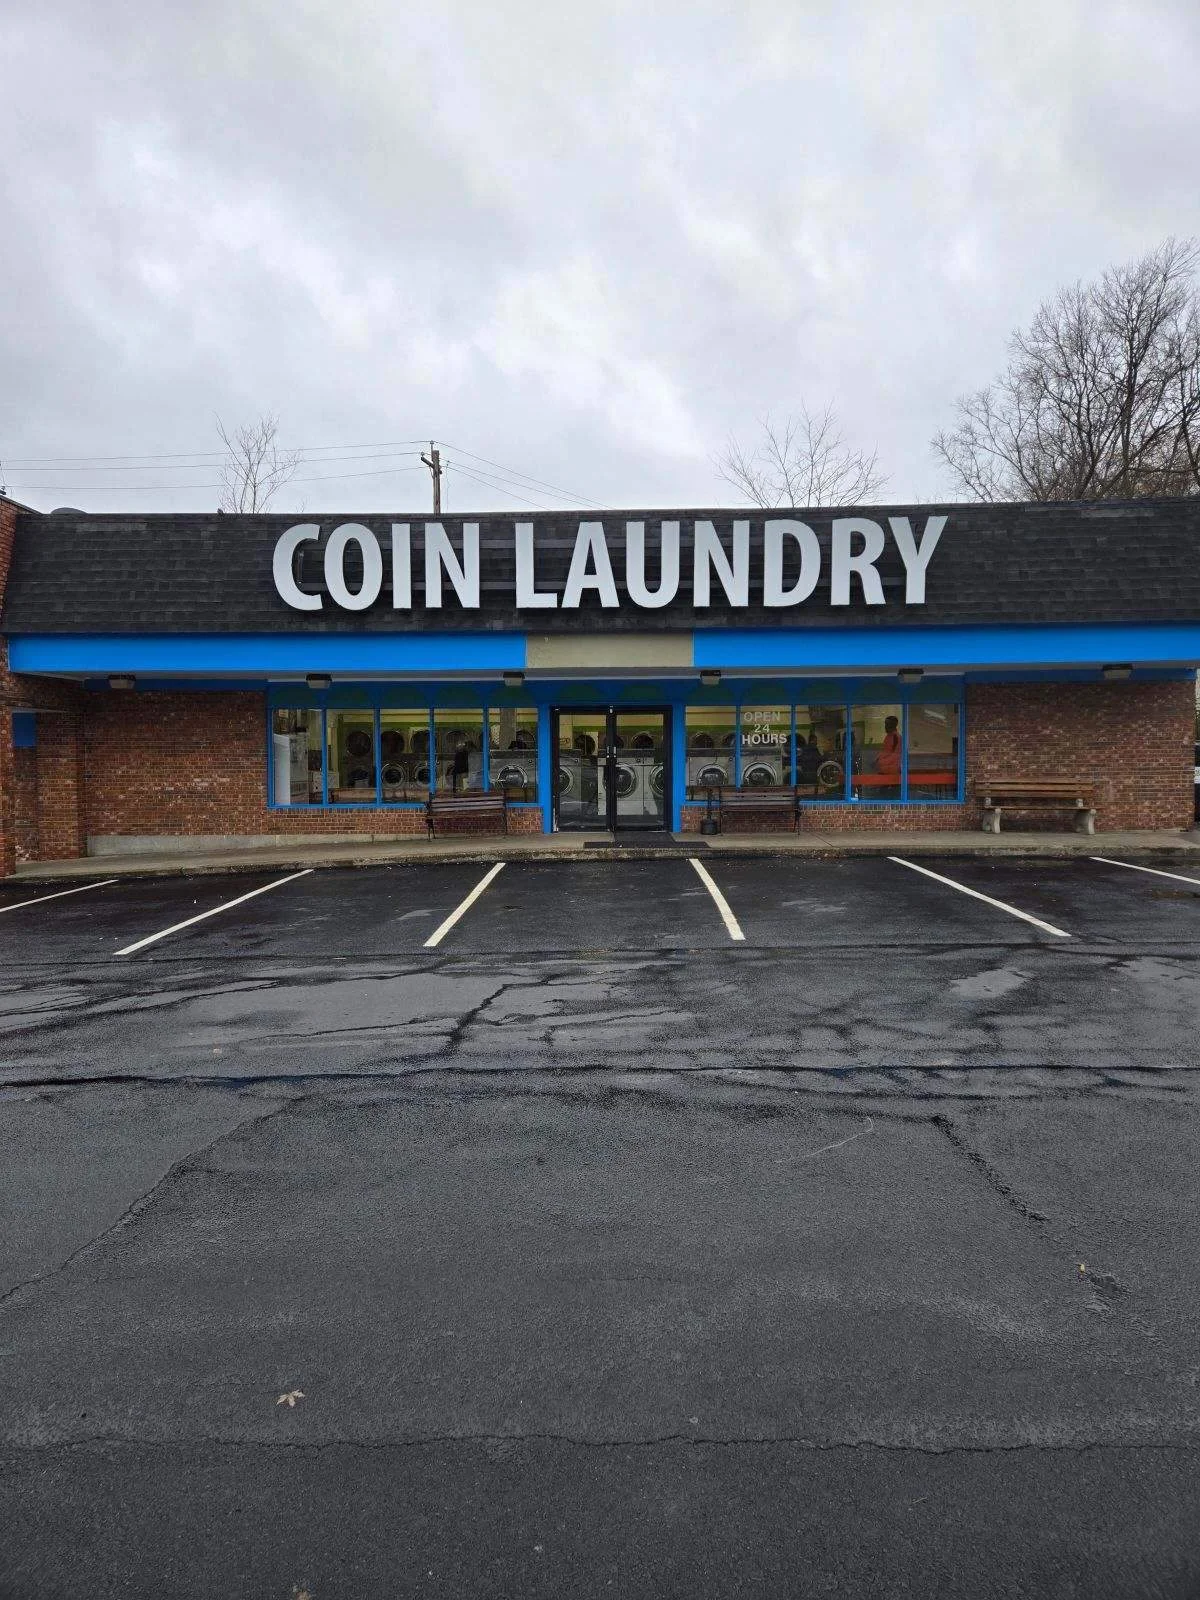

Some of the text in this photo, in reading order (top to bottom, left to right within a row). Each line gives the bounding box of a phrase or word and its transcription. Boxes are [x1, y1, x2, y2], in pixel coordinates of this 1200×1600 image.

[272, 515, 948, 611] COIN LAUNDRY
[743, 711, 781, 722] OPEN
[754, 723, 770, 733] 24
[742, 734, 787, 745] HOURS
